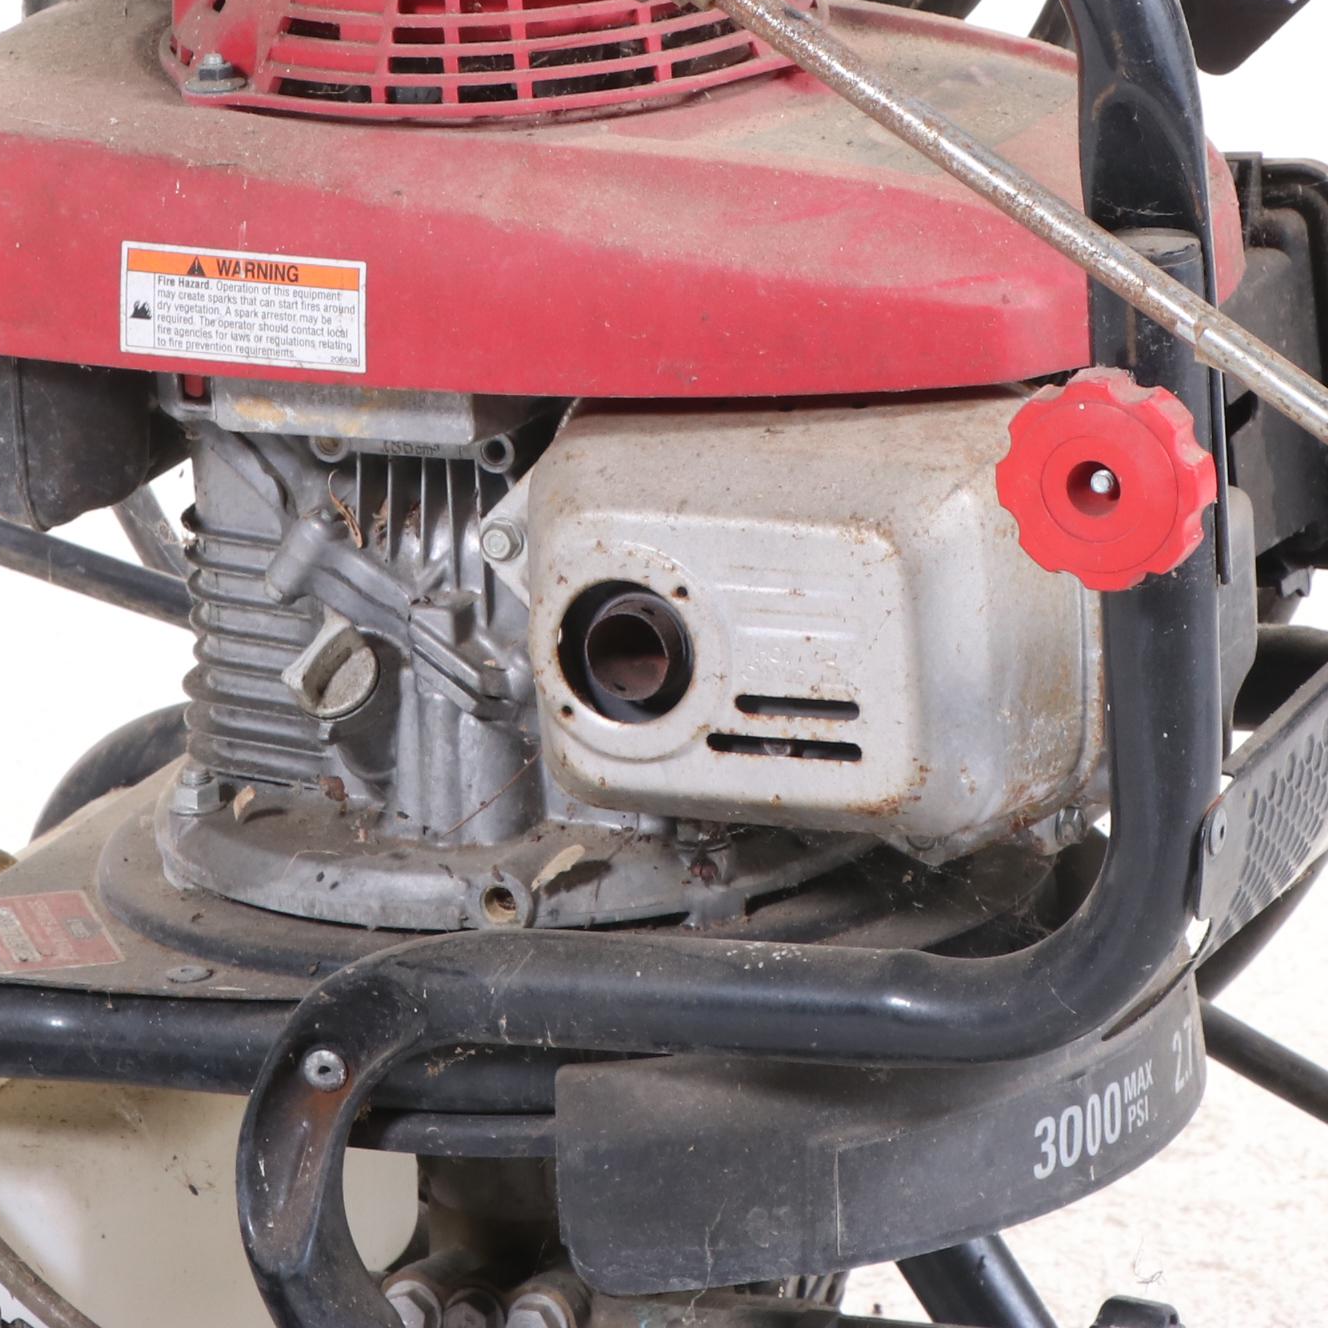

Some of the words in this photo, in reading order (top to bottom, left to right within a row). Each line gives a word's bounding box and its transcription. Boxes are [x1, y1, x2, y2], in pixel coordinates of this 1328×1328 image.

[216, 258, 299, 282] WARNING
[158, 275, 175, 286] Fire
[178, 277, 212, 290] Hazard.
[216, 280, 259, 293] Operation
[262, 285, 272, 295] of
[273, 286, 289, 297] this
[293, 289, 341, 301] equipment
[157, 300, 172, 312] dry
[174, 303, 221, 316] vegetation.
[224, 306, 232, 316] A
[235, 308, 259, 320] spark
[261, 310, 296, 322] arrestor
[299, 314, 318, 325] may
[321, 314, 332, 325] be
[158, 290, 175, 300] may
[178, 292, 205, 302] create
[208, 294, 237, 306] sparks
[240, 295, 257, 306] that
[260, 299, 275, 308] can
[278, 300, 298, 310] start
[301, 302, 320, 312] fires
[324, 304, 355, 315] around
[157, 324, 171, 333] fire
[174, 326, 212, 339] agencies
[215, 330, 227, 339] for
[230, 332, 251, 342] laws
[254, 334, 263, 342] or
[266, 335, 315, 348] regulations
[318, 340, 352, 352] relating
[200, 316, 216, 327] The
[218, 319, 255, 331] operator
[258, 322, 289, 333] should
[291, 325, 324, 337] contact
[327, 328, 348, 339] local
[157, 337, 166, 346] to
[168, 337, 183, 347] fire
[186, 340, 233, 354] prevention
[235, 345, 296, 359] requirements.
[1033, 1082, 1122, 1179] 3000
[1124, 1059, 1154, 1104] MAX
[1127, 1095, 1149, 1134] PSI
